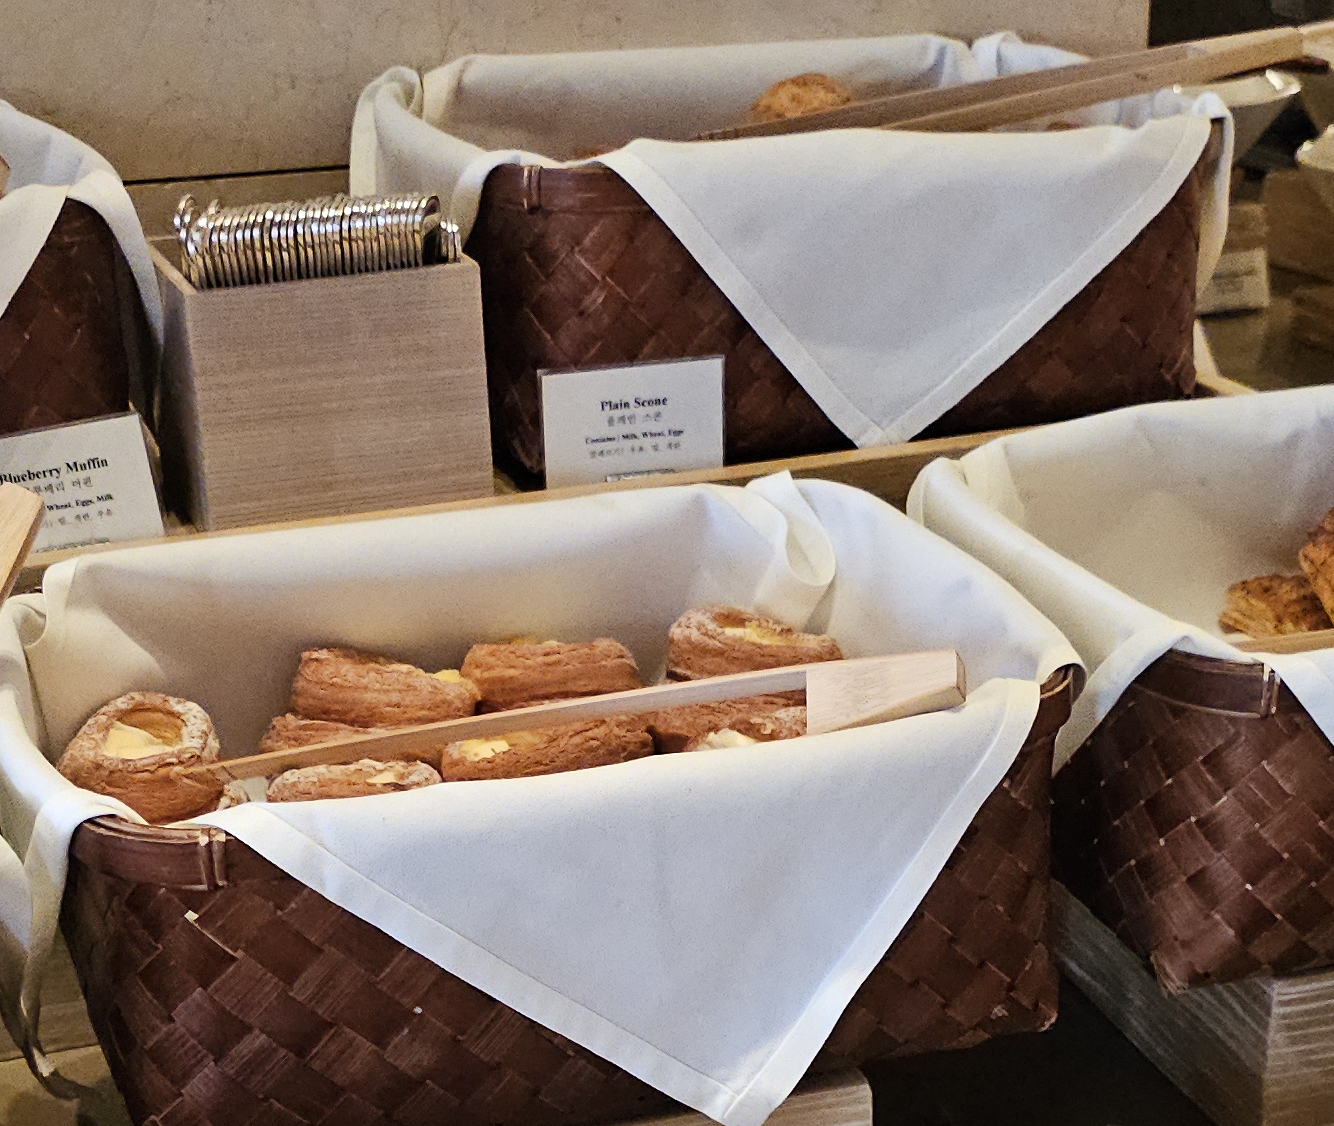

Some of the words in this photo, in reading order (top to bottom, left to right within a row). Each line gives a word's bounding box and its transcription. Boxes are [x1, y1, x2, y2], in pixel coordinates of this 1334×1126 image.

[600, 399, 630, 412] Plain
[633, 397, 668, 408] Scone
[64, 457, 109, 473] Muffin
